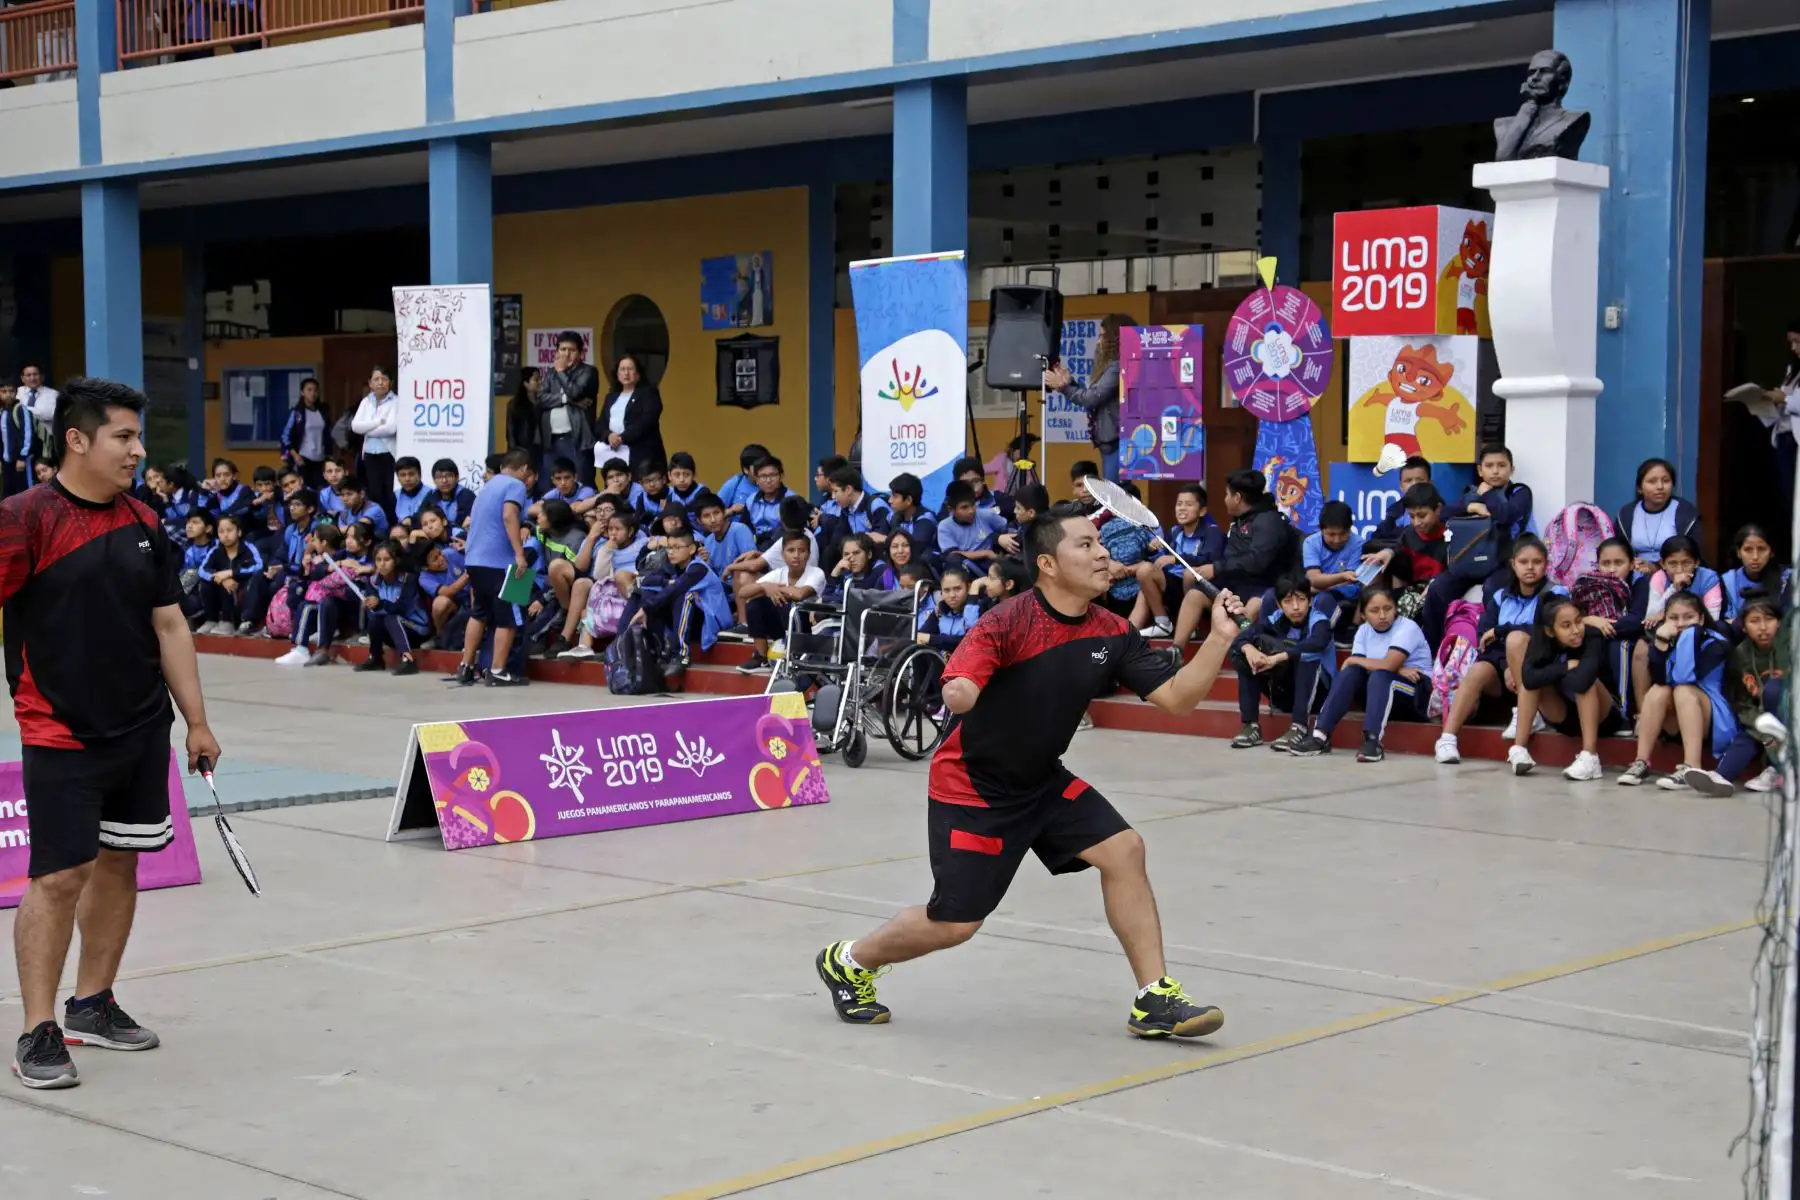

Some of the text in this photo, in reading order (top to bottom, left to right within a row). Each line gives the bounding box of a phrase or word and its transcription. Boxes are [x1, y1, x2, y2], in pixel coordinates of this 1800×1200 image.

[1341, 272, 1428, 312] 2019
[533, 332, 545, 348] IF
[1061, 321, 1096, 338] ABER
[413, 403, 465, 427] 2019
[890, 441, 926, 459] 2019
[603, 757, 664, 787] 2019
[557, 809, 586, 820] JUEGOS
[587, 801, 649, 816] PANAMERICANOS
[656, 791, 732, 807] PARAPANAMERICANOS
